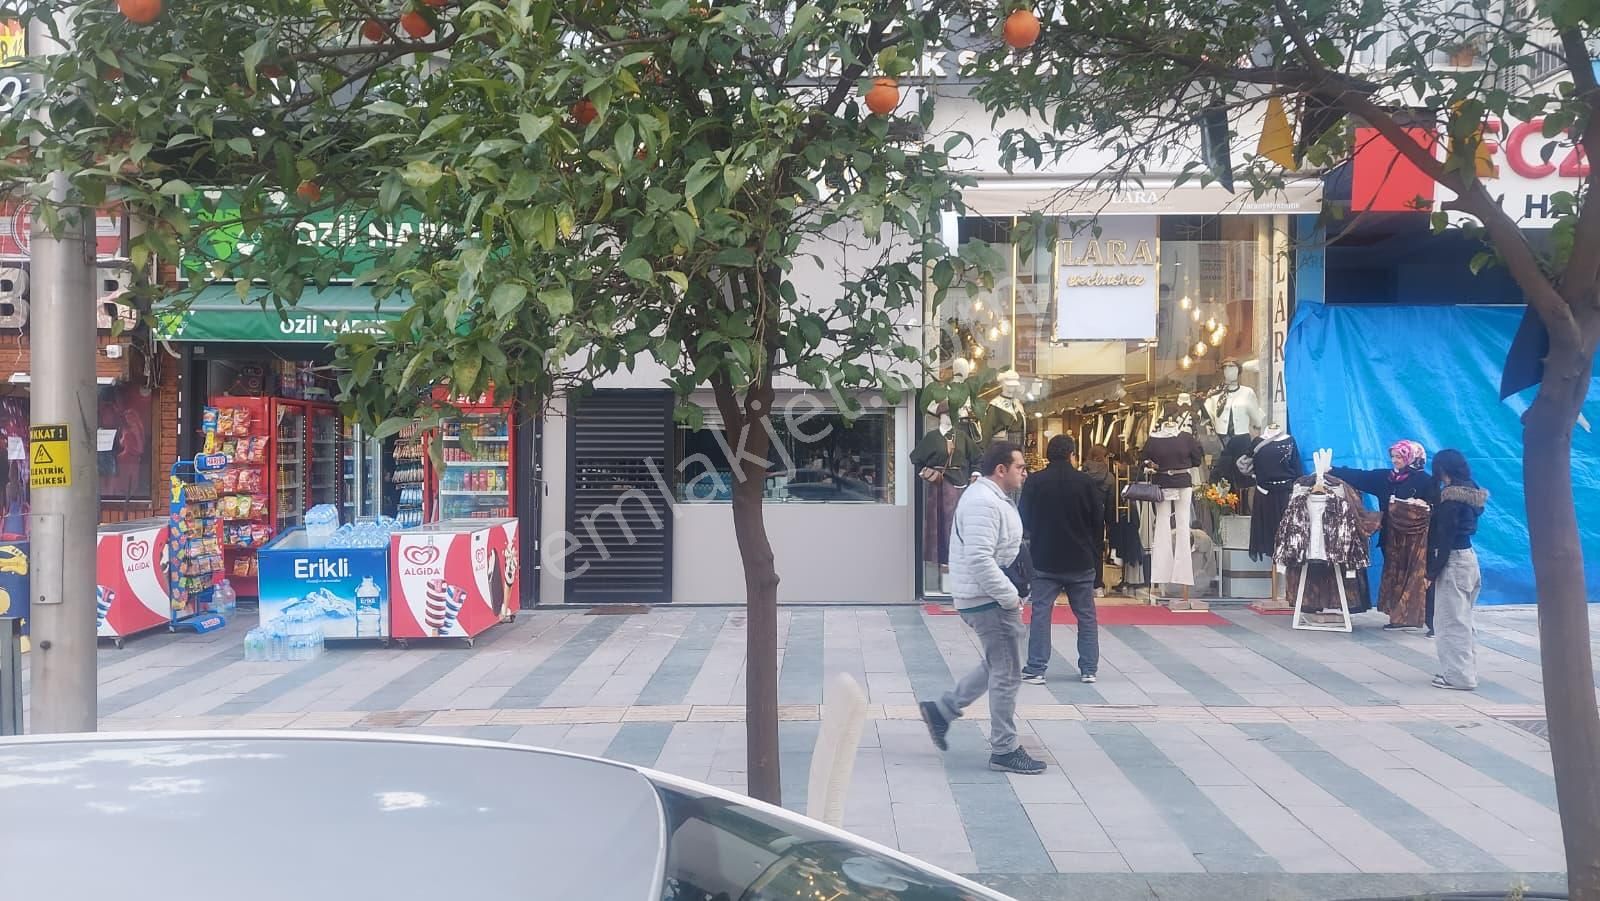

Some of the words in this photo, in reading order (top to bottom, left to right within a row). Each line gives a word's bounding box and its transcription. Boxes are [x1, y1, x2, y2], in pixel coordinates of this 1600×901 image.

[1111, 191, 1158, 204] LARA
[1060, 239, 1155, 266] LARA
[1272, 251, 1288, 403] LARA
[294, 557, 348, 578] Erikli
